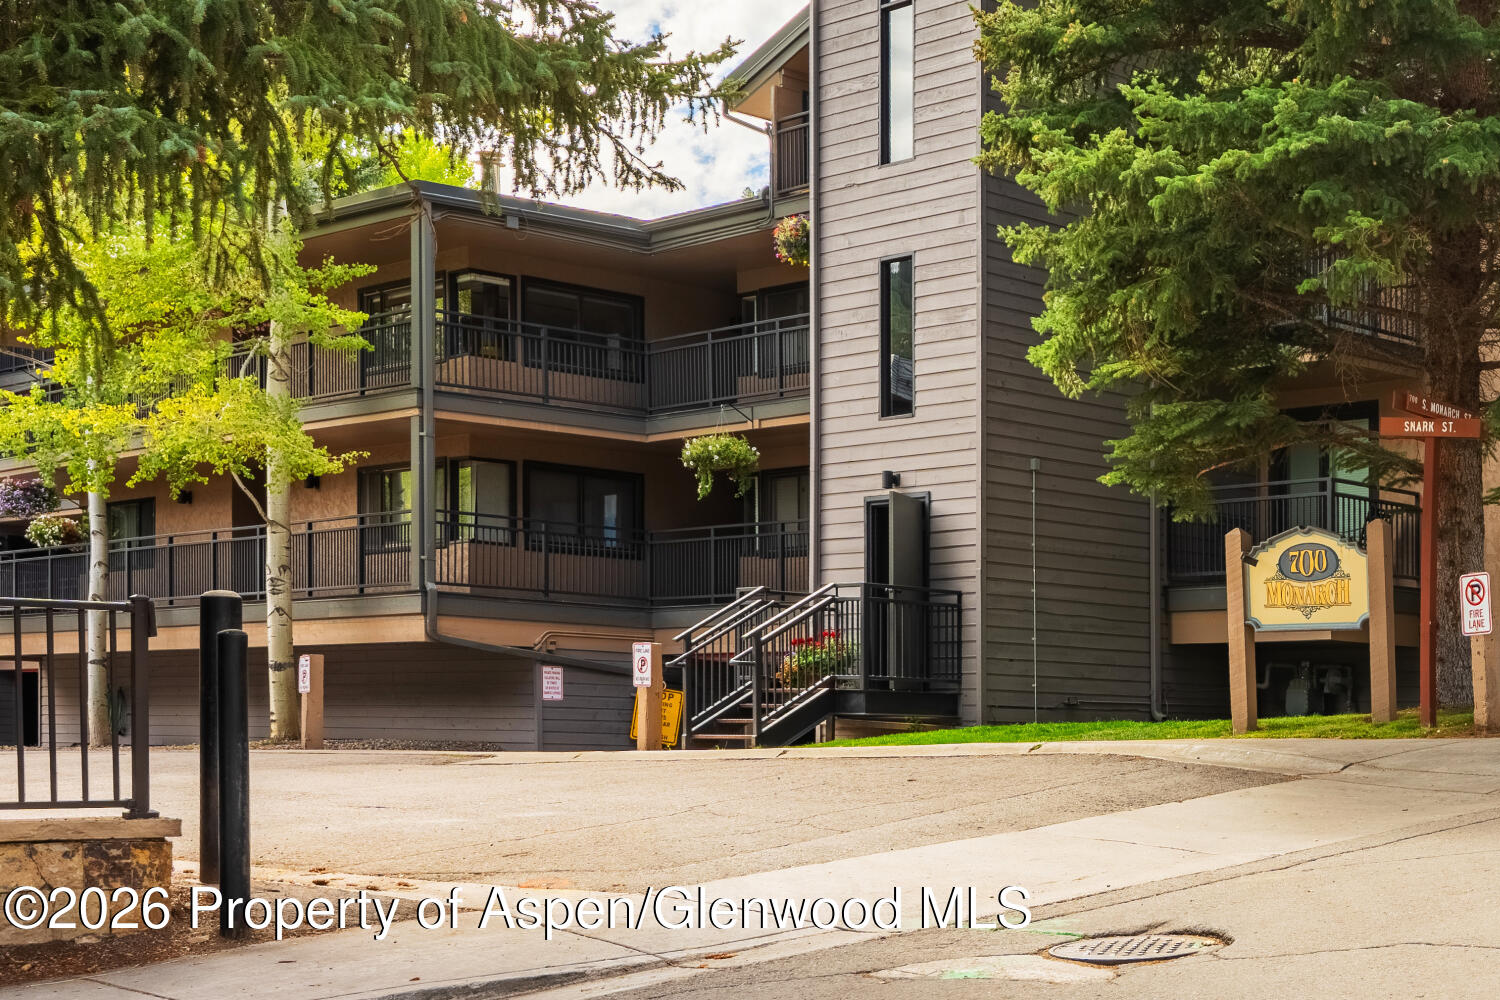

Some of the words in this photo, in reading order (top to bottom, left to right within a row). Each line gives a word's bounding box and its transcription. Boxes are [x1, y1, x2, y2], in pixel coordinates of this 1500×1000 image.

[1422, 398, 1429, 412] S.
[1430, 402, 1460, 419] MONARCH
[1404, 420, 1435, 433] SNARK
[1441, 421, 1457, 433] ST.
[1288, 549, 1328, 577] 700
[1264, 578, 1352, 608] MONARCH
[1469, 608, 1484, 619] FIRE
[1468, 619, 1486, 629] LANE
